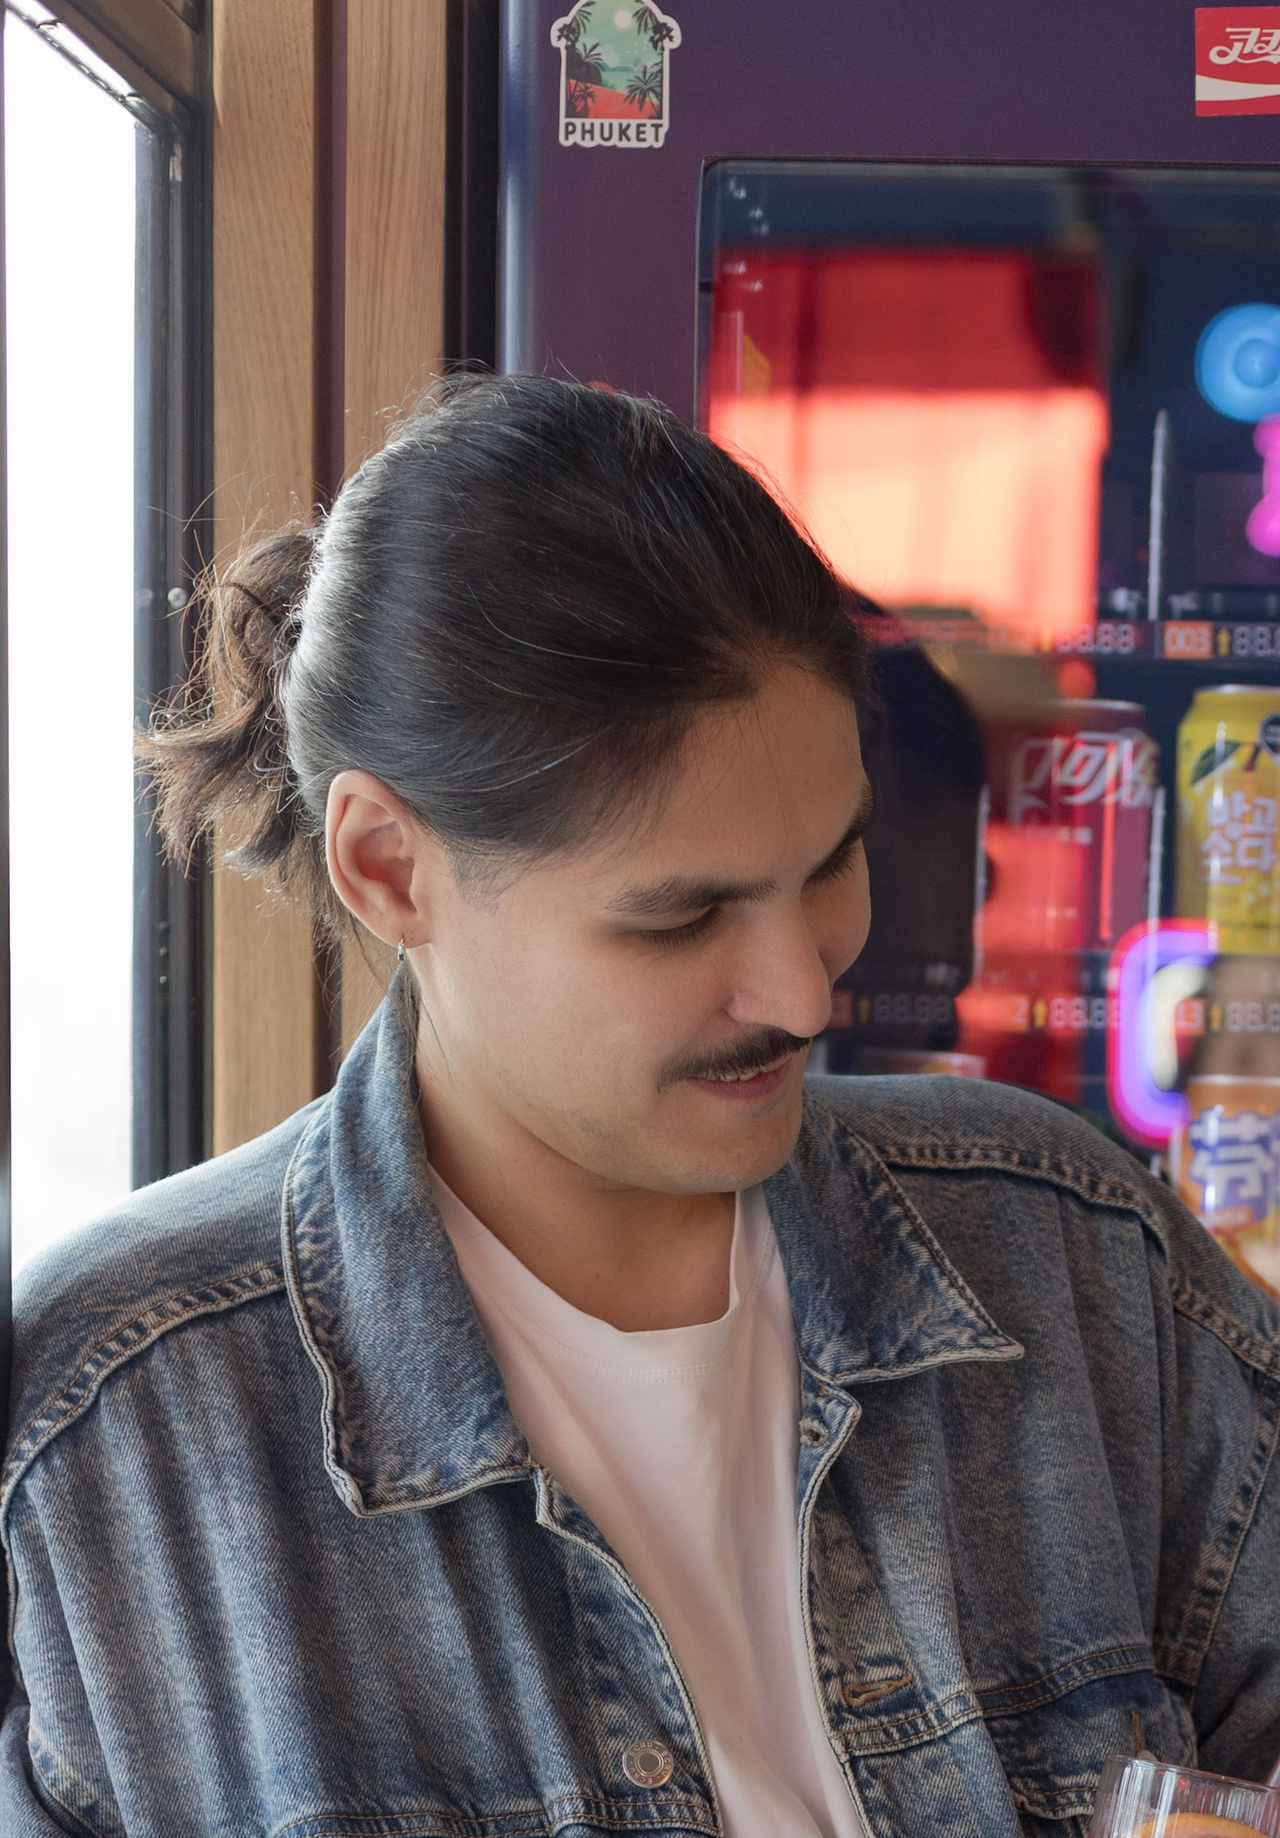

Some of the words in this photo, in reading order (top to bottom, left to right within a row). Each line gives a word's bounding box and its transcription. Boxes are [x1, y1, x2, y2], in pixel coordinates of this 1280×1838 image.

[564, 121, 663, 142] PHUKET
[1165, 627, 1211, 655] 003
[1207, 791, 1278, 839] 망고
[1202, 831, 1279, 873] 소다
[1168, 1003, 1203, 1032] 13
